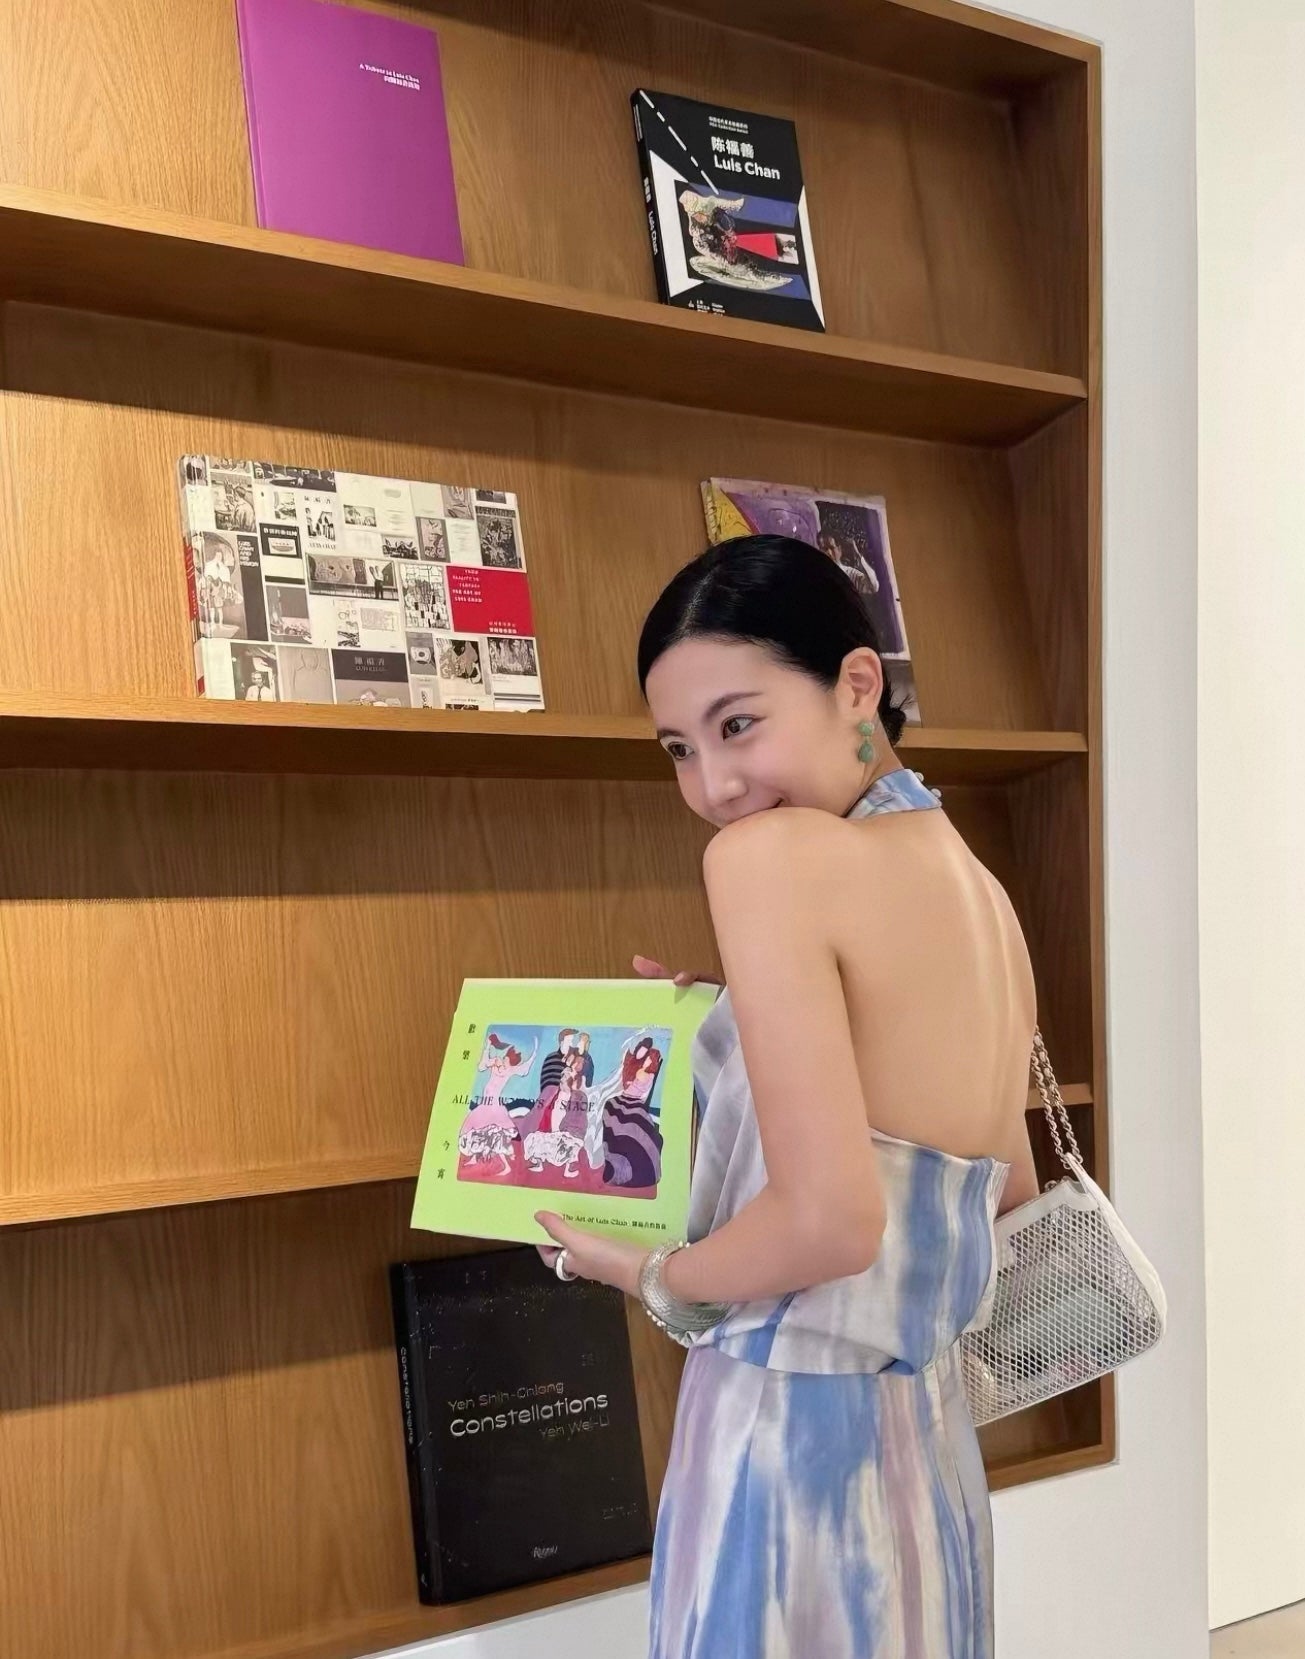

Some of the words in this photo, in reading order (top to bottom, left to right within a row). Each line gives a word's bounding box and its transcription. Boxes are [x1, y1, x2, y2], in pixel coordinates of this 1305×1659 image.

[710, 135, 755, 160] 陈福善
[713, 154, 743, 173] Luis
[744, 161, 781, 180] Chan
[452, 1094, 470, 1105] ALL
[474, 1095, 495, 1106] THE
[575, 1215, 586, 1223] Art
[610, 1218, 628, 1227] Chan
[449, 1393, 609, 1438] Constellations
